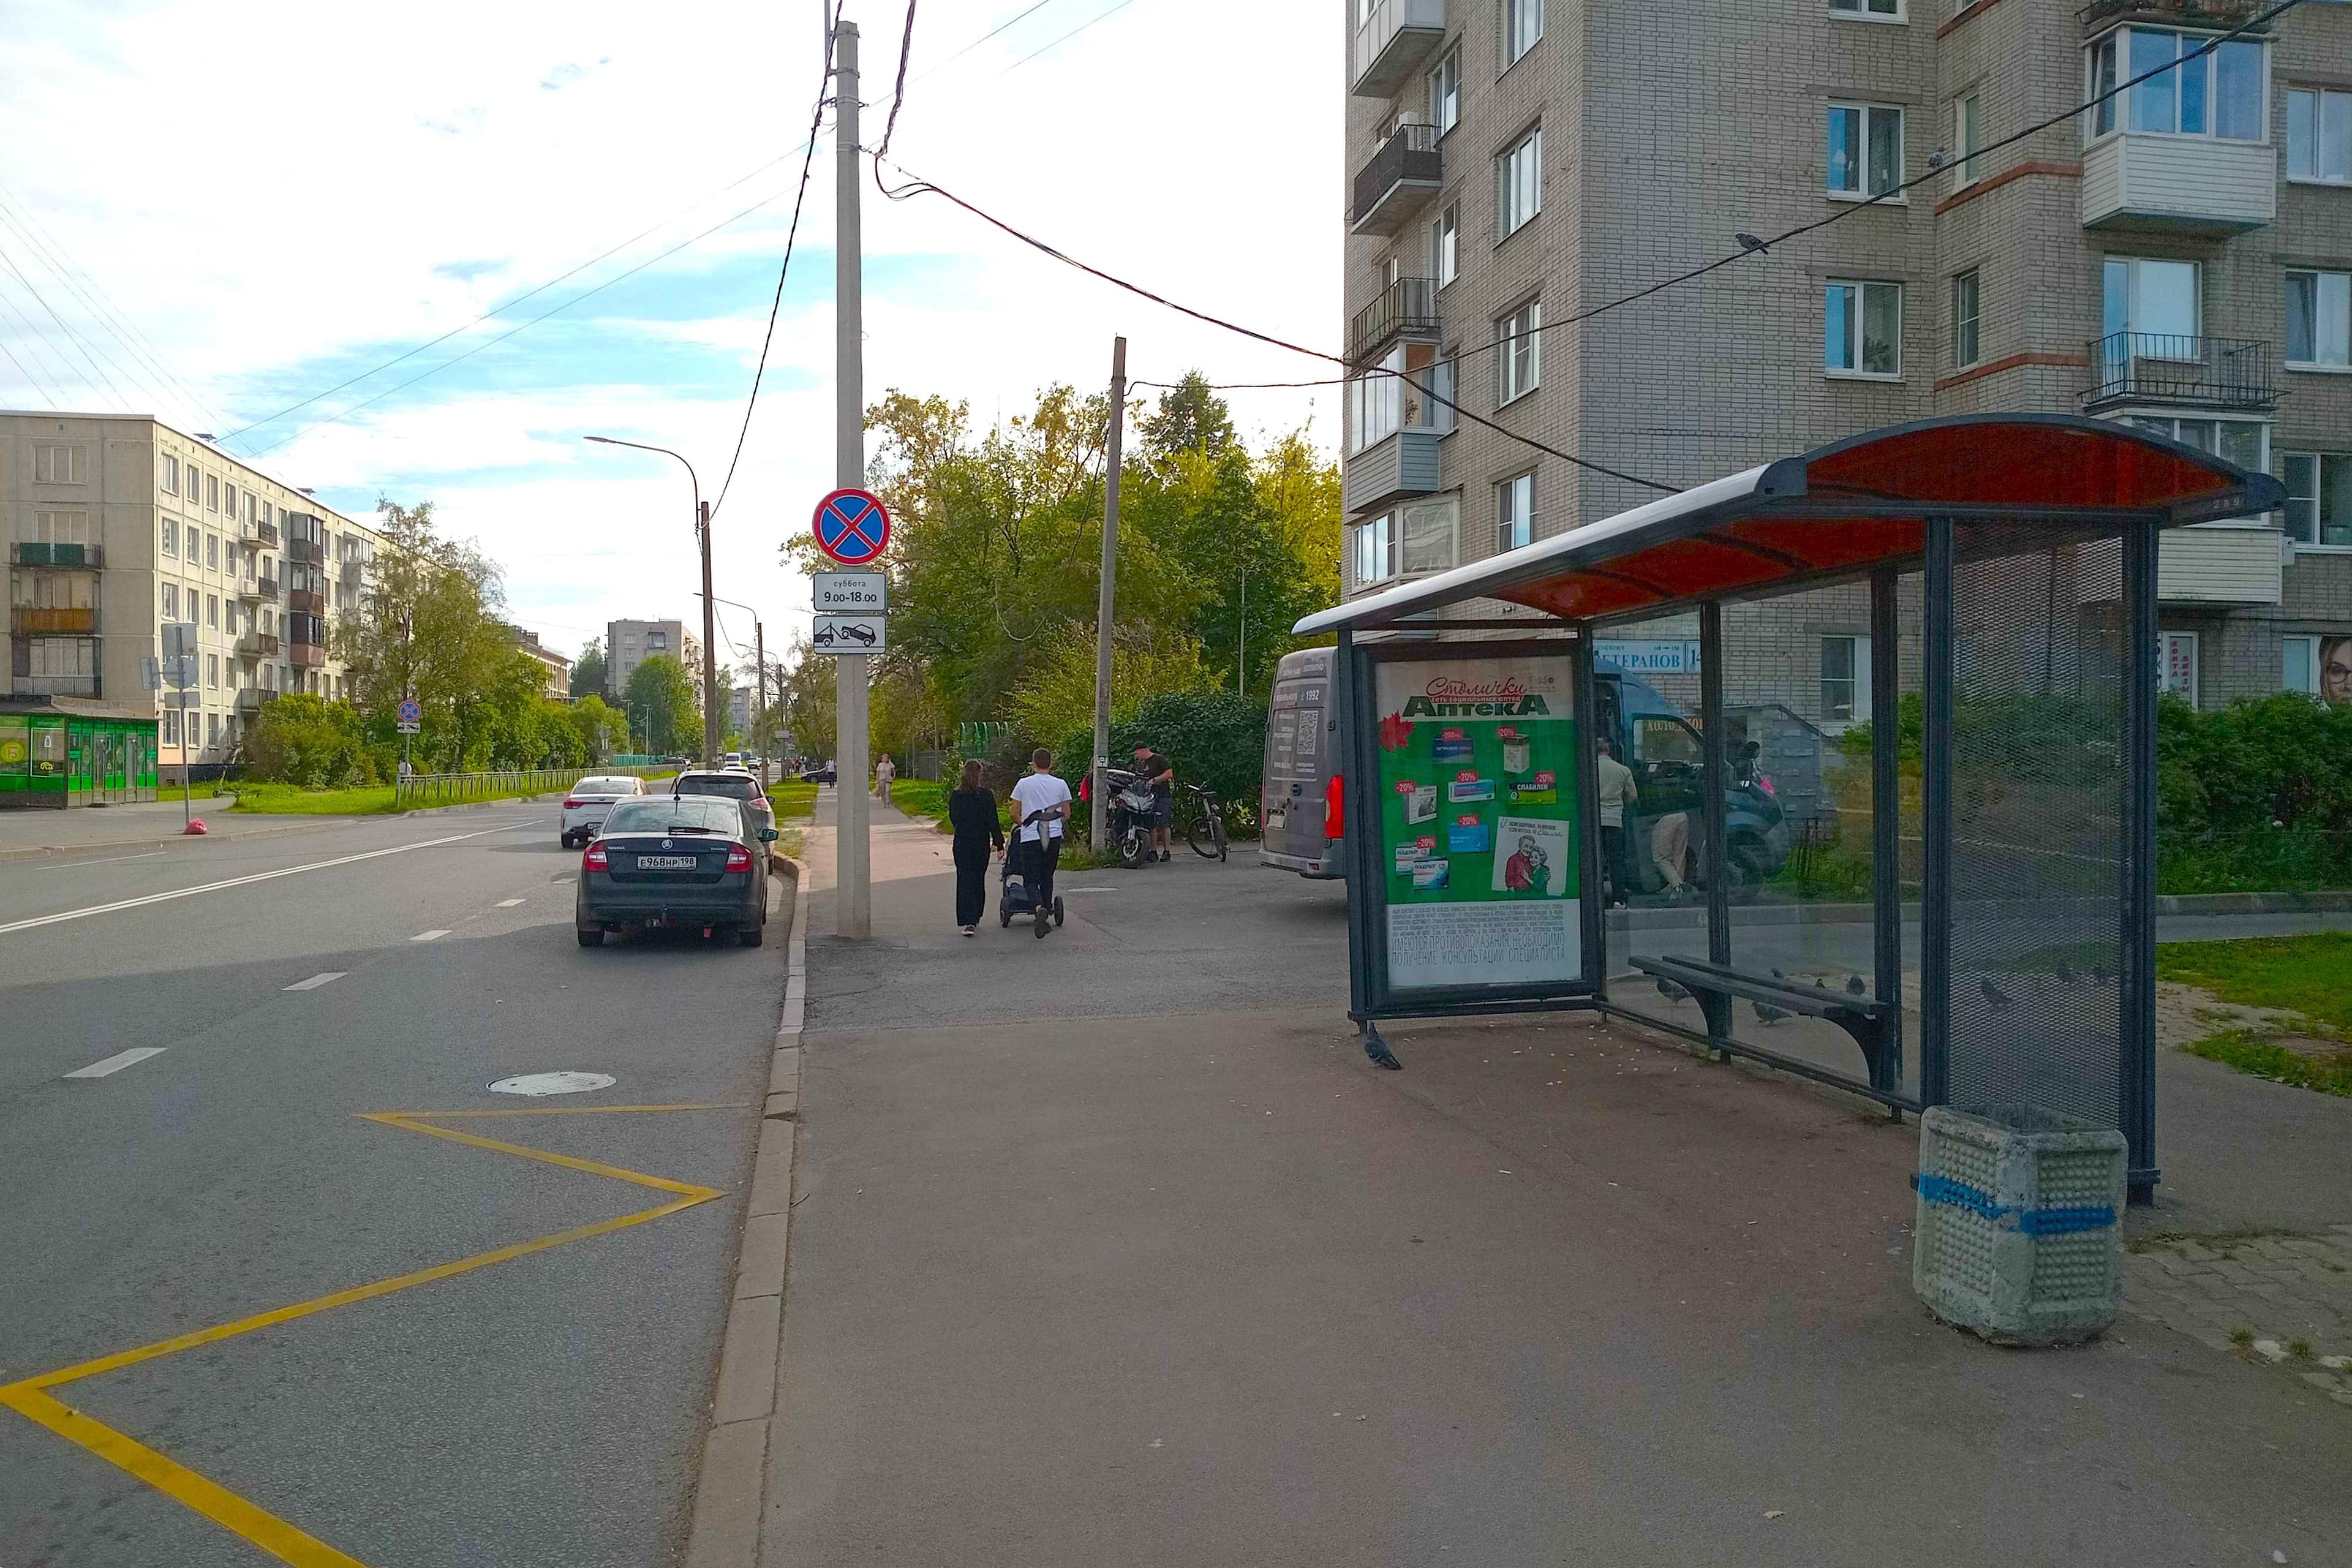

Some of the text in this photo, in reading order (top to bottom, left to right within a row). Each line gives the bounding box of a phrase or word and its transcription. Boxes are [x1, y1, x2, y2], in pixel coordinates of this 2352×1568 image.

[824, 592, 877, 602] 9.00-18.00
[1425, 677, 1528, 696] Столички
[1305, 689, 1320, 701] 1992
[1458, 772, 1476, 781] -20%
[1459, 816, 1476, 825] -20%
[1392, 936, 1428, 951] ИМЕЮТСЯ
[1512, 932, 1565, 947] НЕОБХОДИМО
[1392, 947, 1566, 966] ПОЛУЧЕНИЕ КОНСУЛЬТАЦИИ СПЕЦИАЛИСТА
